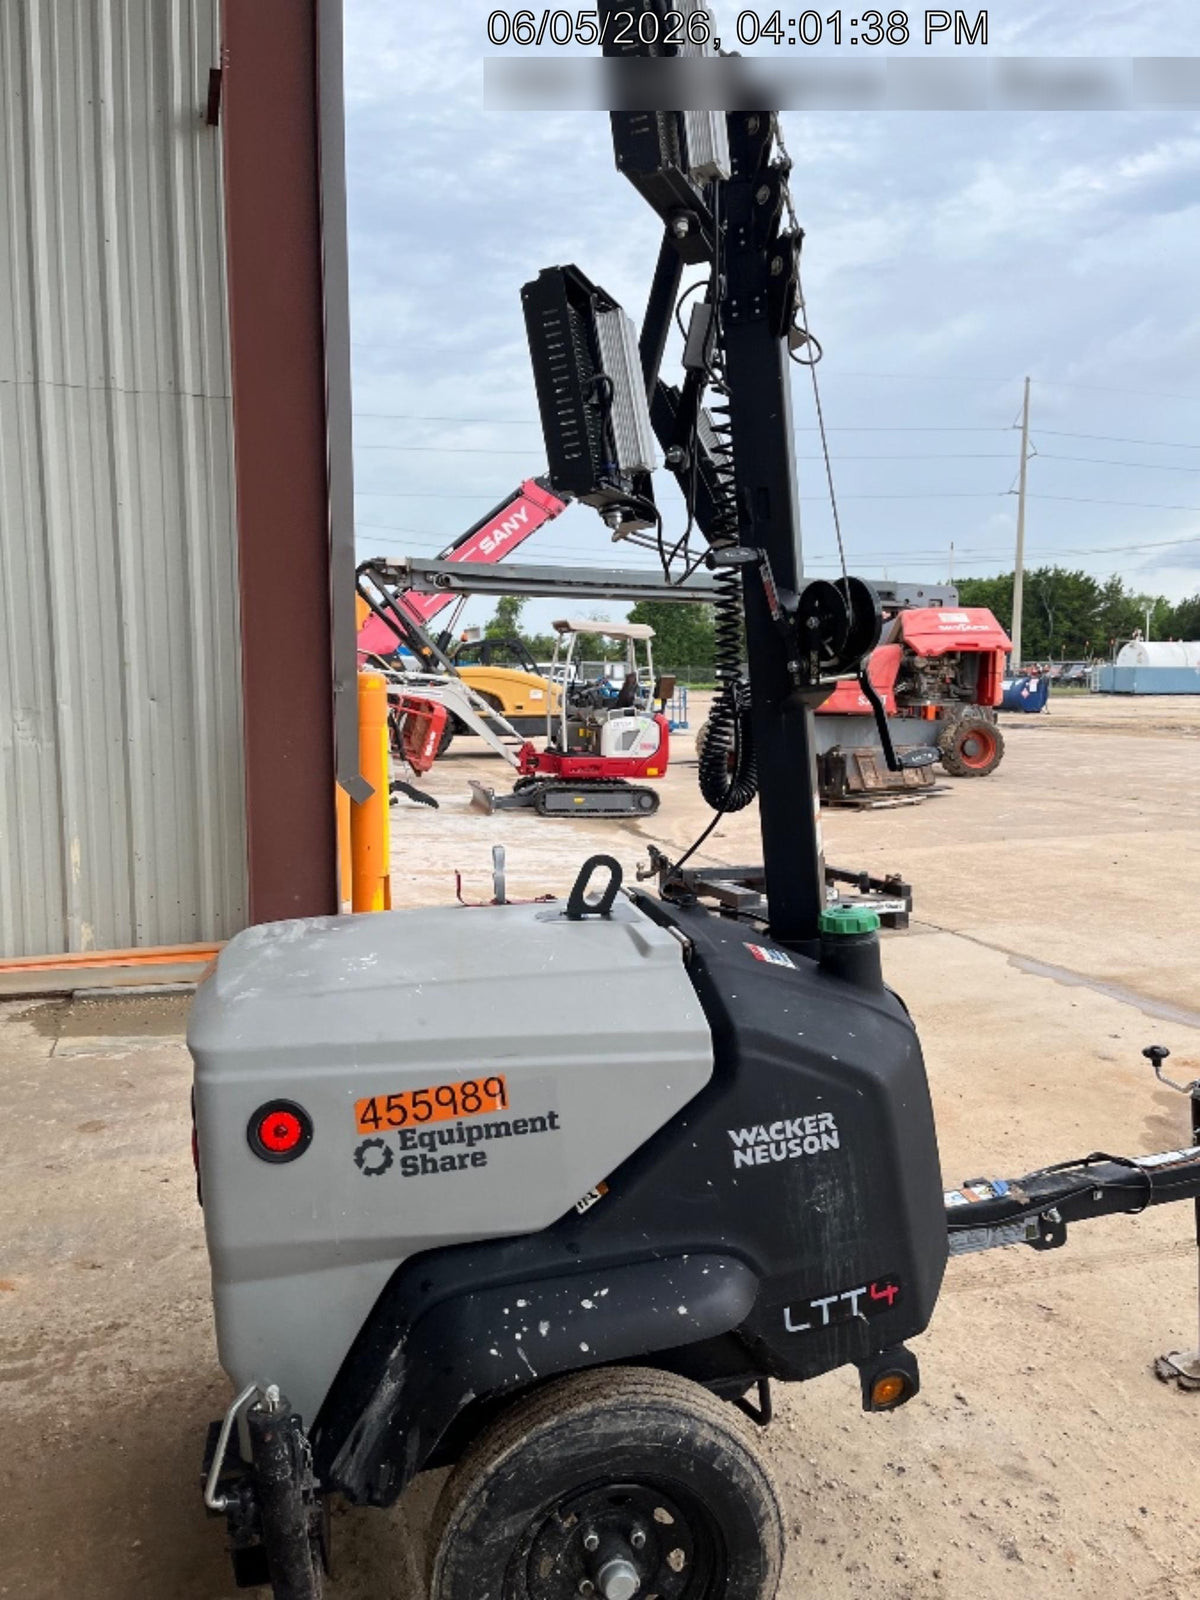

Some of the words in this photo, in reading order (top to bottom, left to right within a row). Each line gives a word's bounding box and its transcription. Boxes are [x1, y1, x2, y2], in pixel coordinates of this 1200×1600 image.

[479, 506, 529, 556] SANY
[360, 1076, 507, 1130] 455989
[398, 1110, 560, 1152] Equipment
[727, 1112, 838, 1148] WACKER
[732, 1130, 840, 1169] NEUSON
[400, 1150, 488, 1177] Share
[783, 1283, 899, 1332] LTT4
